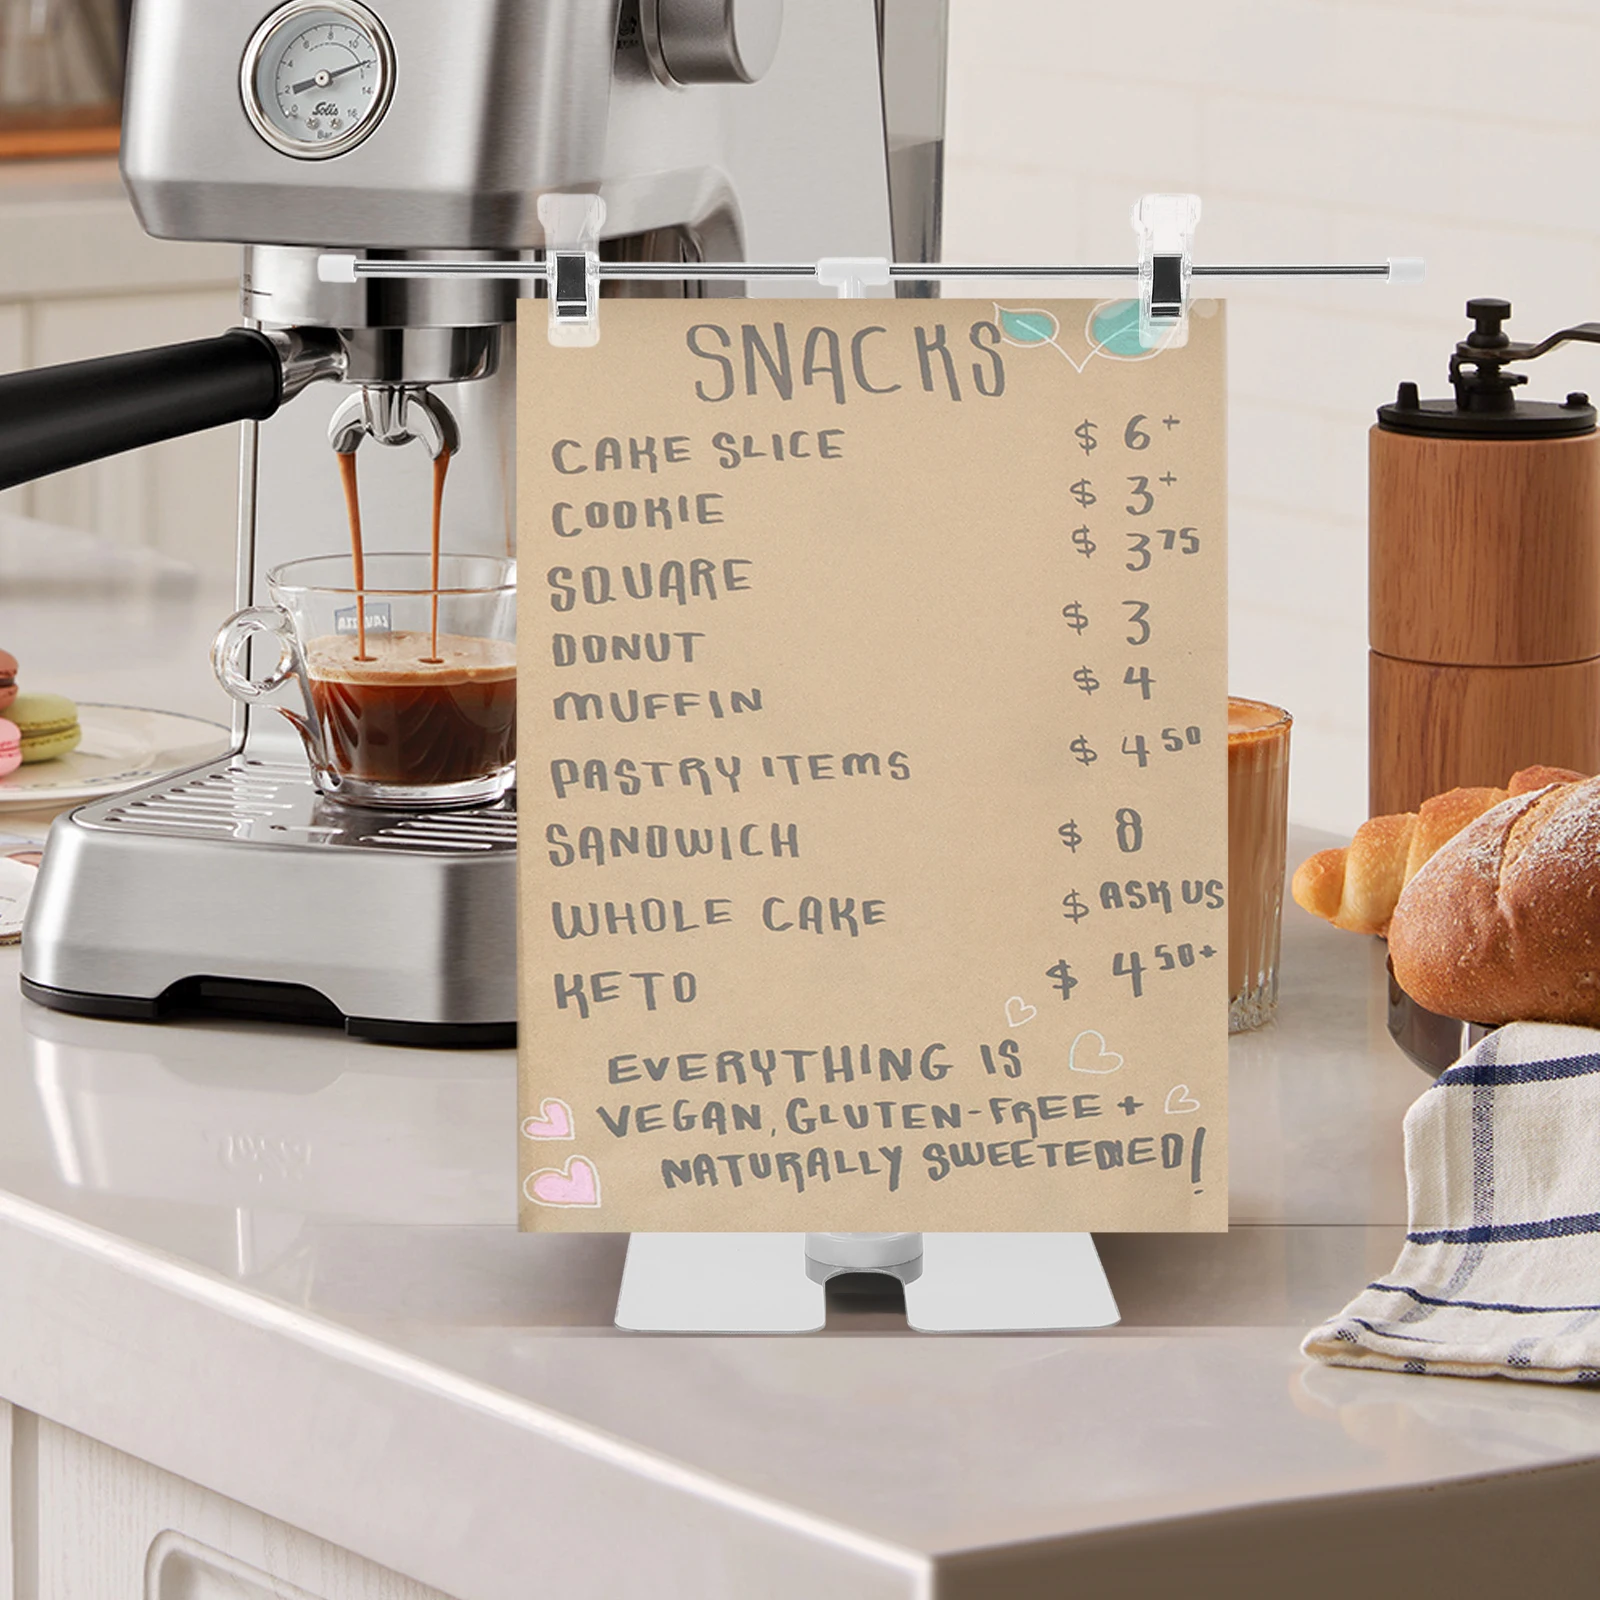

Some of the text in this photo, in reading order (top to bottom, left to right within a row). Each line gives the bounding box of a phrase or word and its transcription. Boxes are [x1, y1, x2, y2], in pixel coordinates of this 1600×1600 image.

[348, 40, 359, 49] 10
[312, 101, 339, 116] Solis
[317, 130, 333, 139] Bar
[687, 321, 1005, 404] SNACKS
[552, 436, 691, 474] CAKE
[712, 429, 845, 469] SLICE
[552, 494, 725, 537] COOKIE
[547, 559, 753, 612] SQUARE
[552, 632, 706, 667] DONUT
[1122, 600, 1150, 646] 3
[553, 689, 763, 723] MUFFIN
[1123, 667, 1155, 701] 4
[551, 756, 741, 799] PASTRY
[763, 752, 910, 786] ITEMS
[546, 823, 800, 867] SANDWICH
[1115, 808, 1142, 853] 8
[552, 898, 733, 940] WHOLE
[763, 896, 887, 938] CAKE
[1099, 880, 1173, 914] ASK
[1182, 879, 1225, 909] US
[554, 970, 697, 1019] KETO
[608, 1038, 1021, 1087] EVERYTHING IS
[786, 1094, 1103, 1140] GLUTEN-FREE
[662, 1145, 903, 1194] NATURALLY
